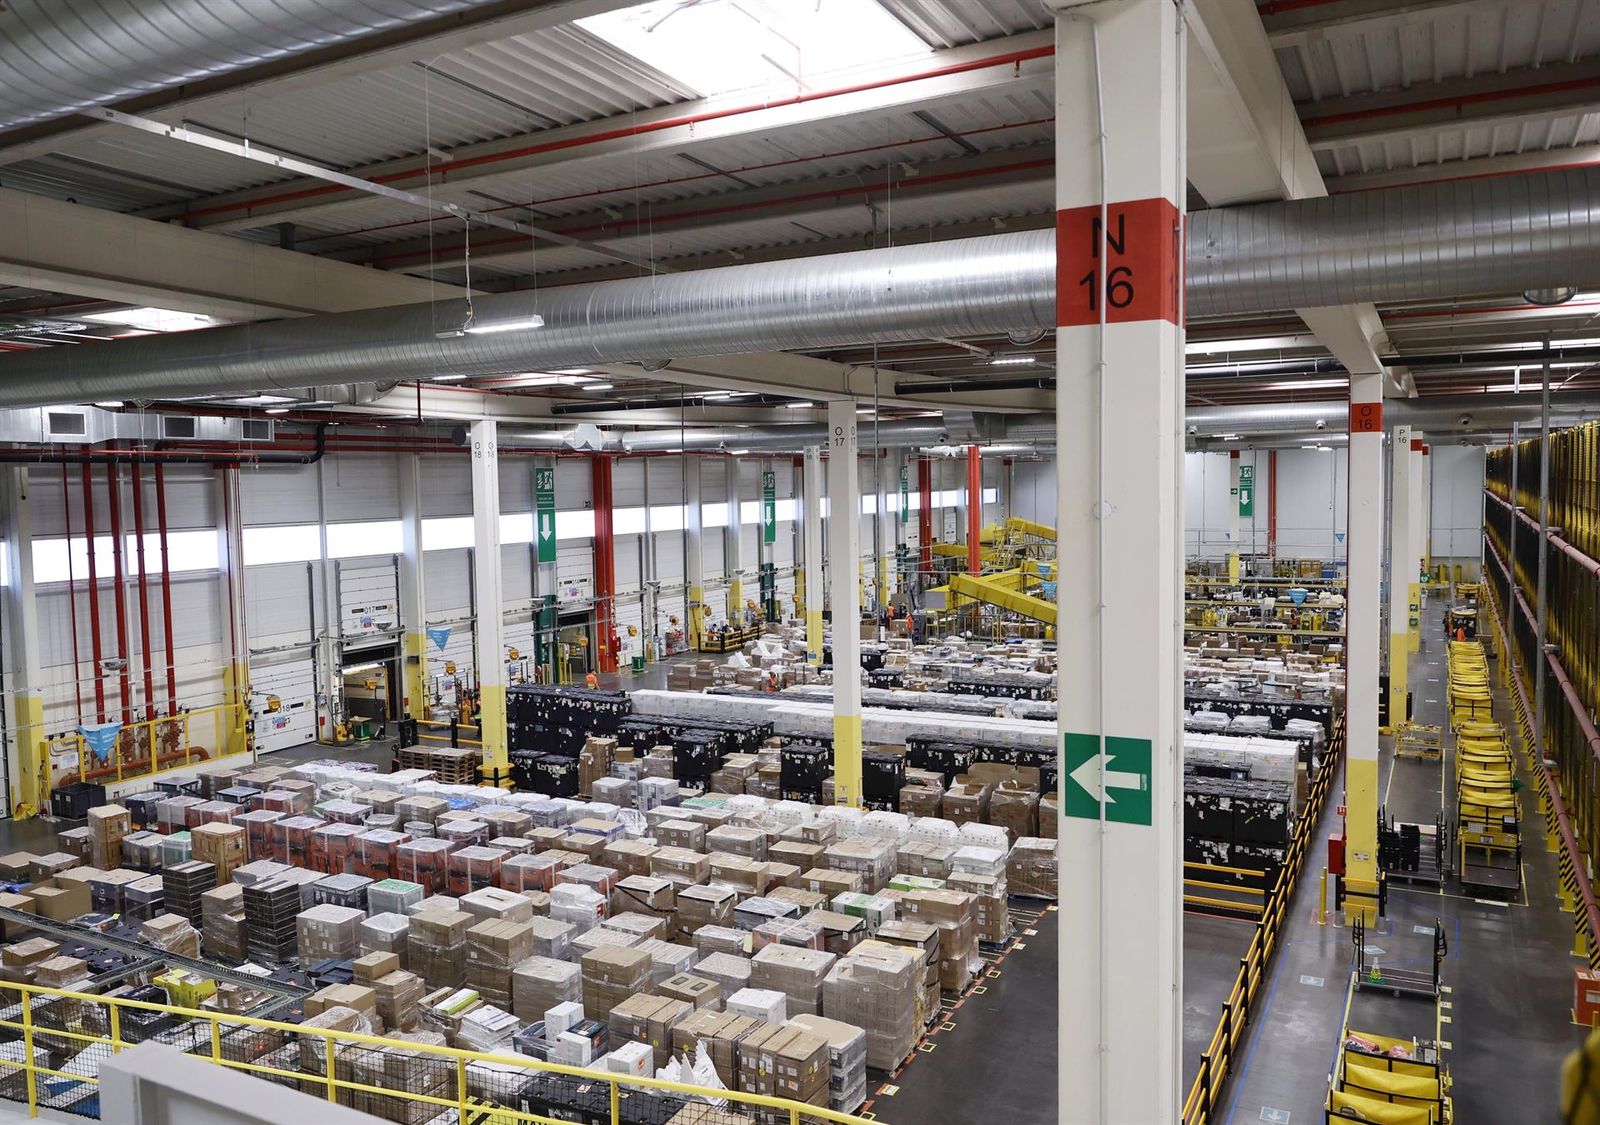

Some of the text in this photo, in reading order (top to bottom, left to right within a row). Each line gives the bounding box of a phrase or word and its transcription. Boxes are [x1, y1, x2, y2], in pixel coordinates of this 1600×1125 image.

[1092, 213, 1125, 258] N
[1079, 266, 1134, 311] 16
[1358, 419, 1373, 430] 16
[1399, 429, 1406, 437] P
[834, 437, 845, 447] 17
[474, 450, 482, 459] 18
[363, 605, 376, 615] 017
